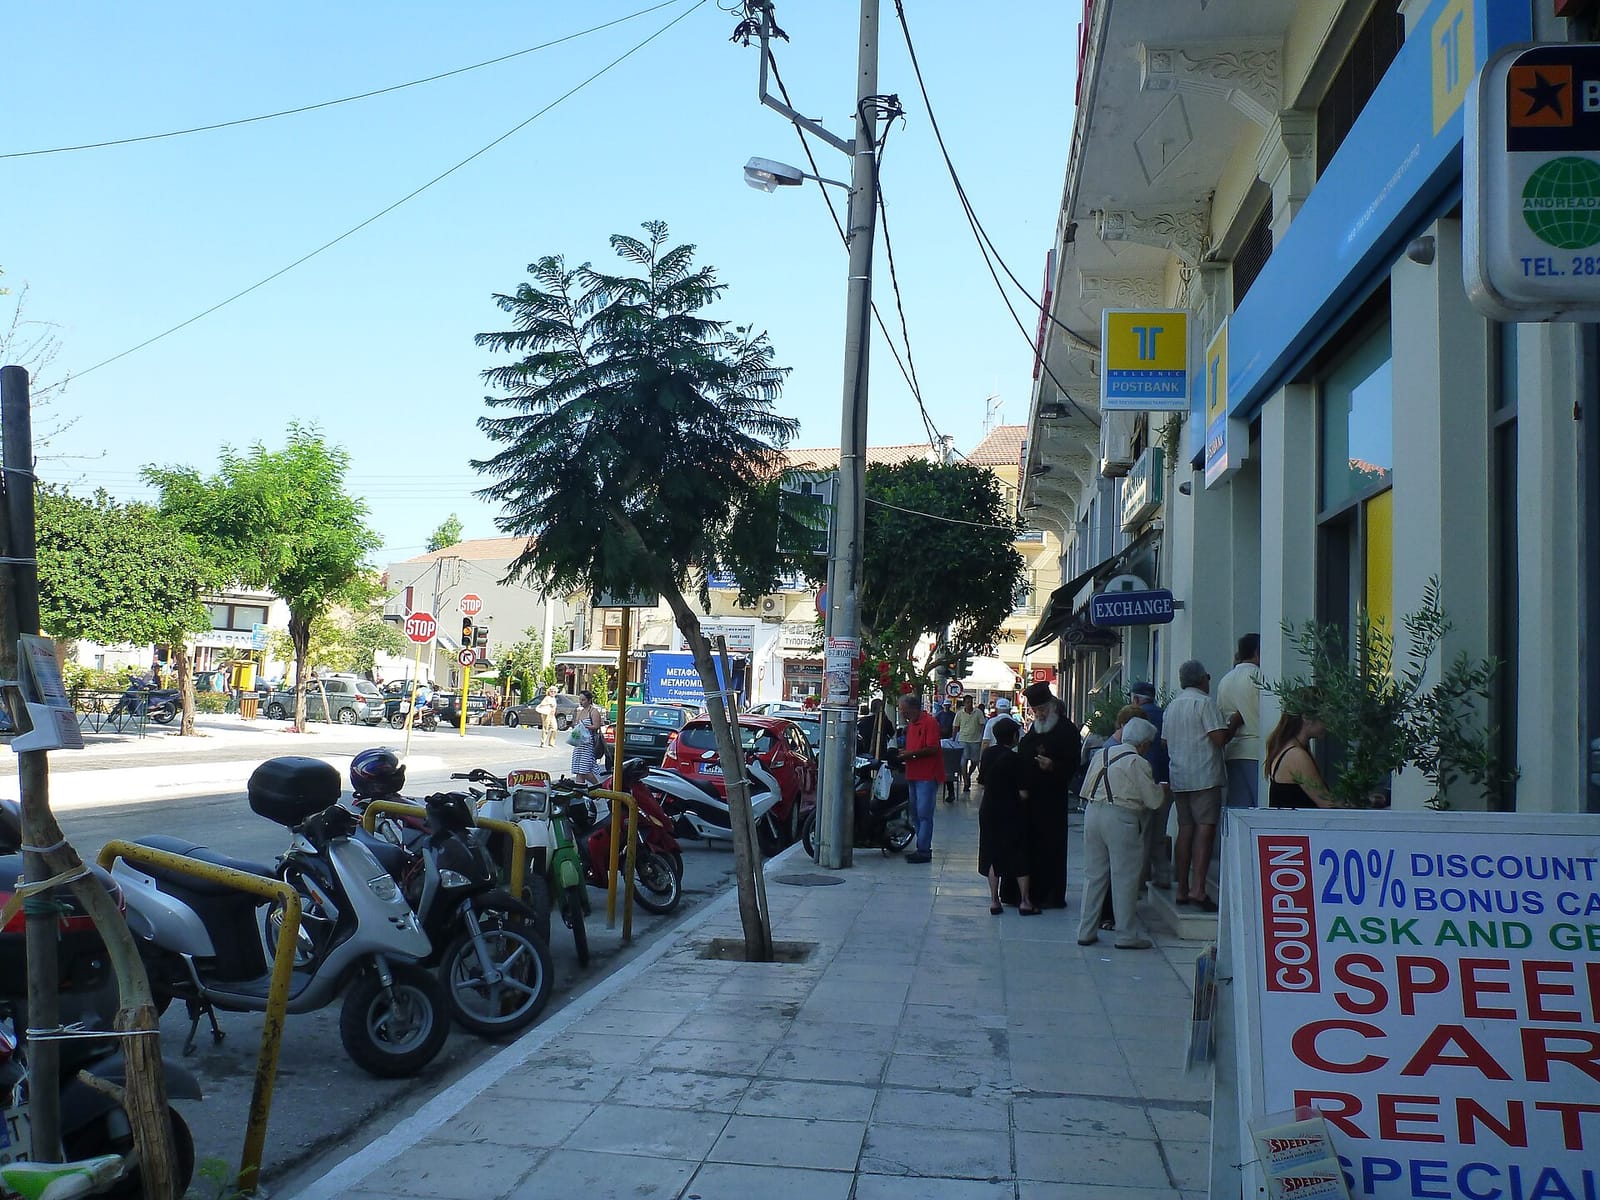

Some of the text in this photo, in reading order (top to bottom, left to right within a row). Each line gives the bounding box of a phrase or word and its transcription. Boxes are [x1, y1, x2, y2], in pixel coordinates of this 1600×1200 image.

[1523, 198, 1600, 209] ANDREAD
[1520, 256, 1565, 277] TEL.
[1112, 381, 1179, 392] POSTBANK
[460, 599, 481, 611] STOP
[1095, 598, 1172, 618] EXCHANGE
[406, 619, 435, 637] STOP
[1318, 848, 1407, 908] 20%
[1410, 853, 1598, 881] DISCOUNT
[1414, 887, 1545, 914] BONUS
[1268, 845, 1313, 991] COUPON
[1326, 915, 1423, 946] ASK
[1434, 919, 1533, 949] AND
[1333, 953, 1600, 1024] SPEE
[1291, 1019, 1600, 1084] CAR
[1293, 1089, 1600, 1151] RENT
[1269, 1138, 1309, 1153] SPEED
[1283, 1177, 1322, 1193] SPEED
